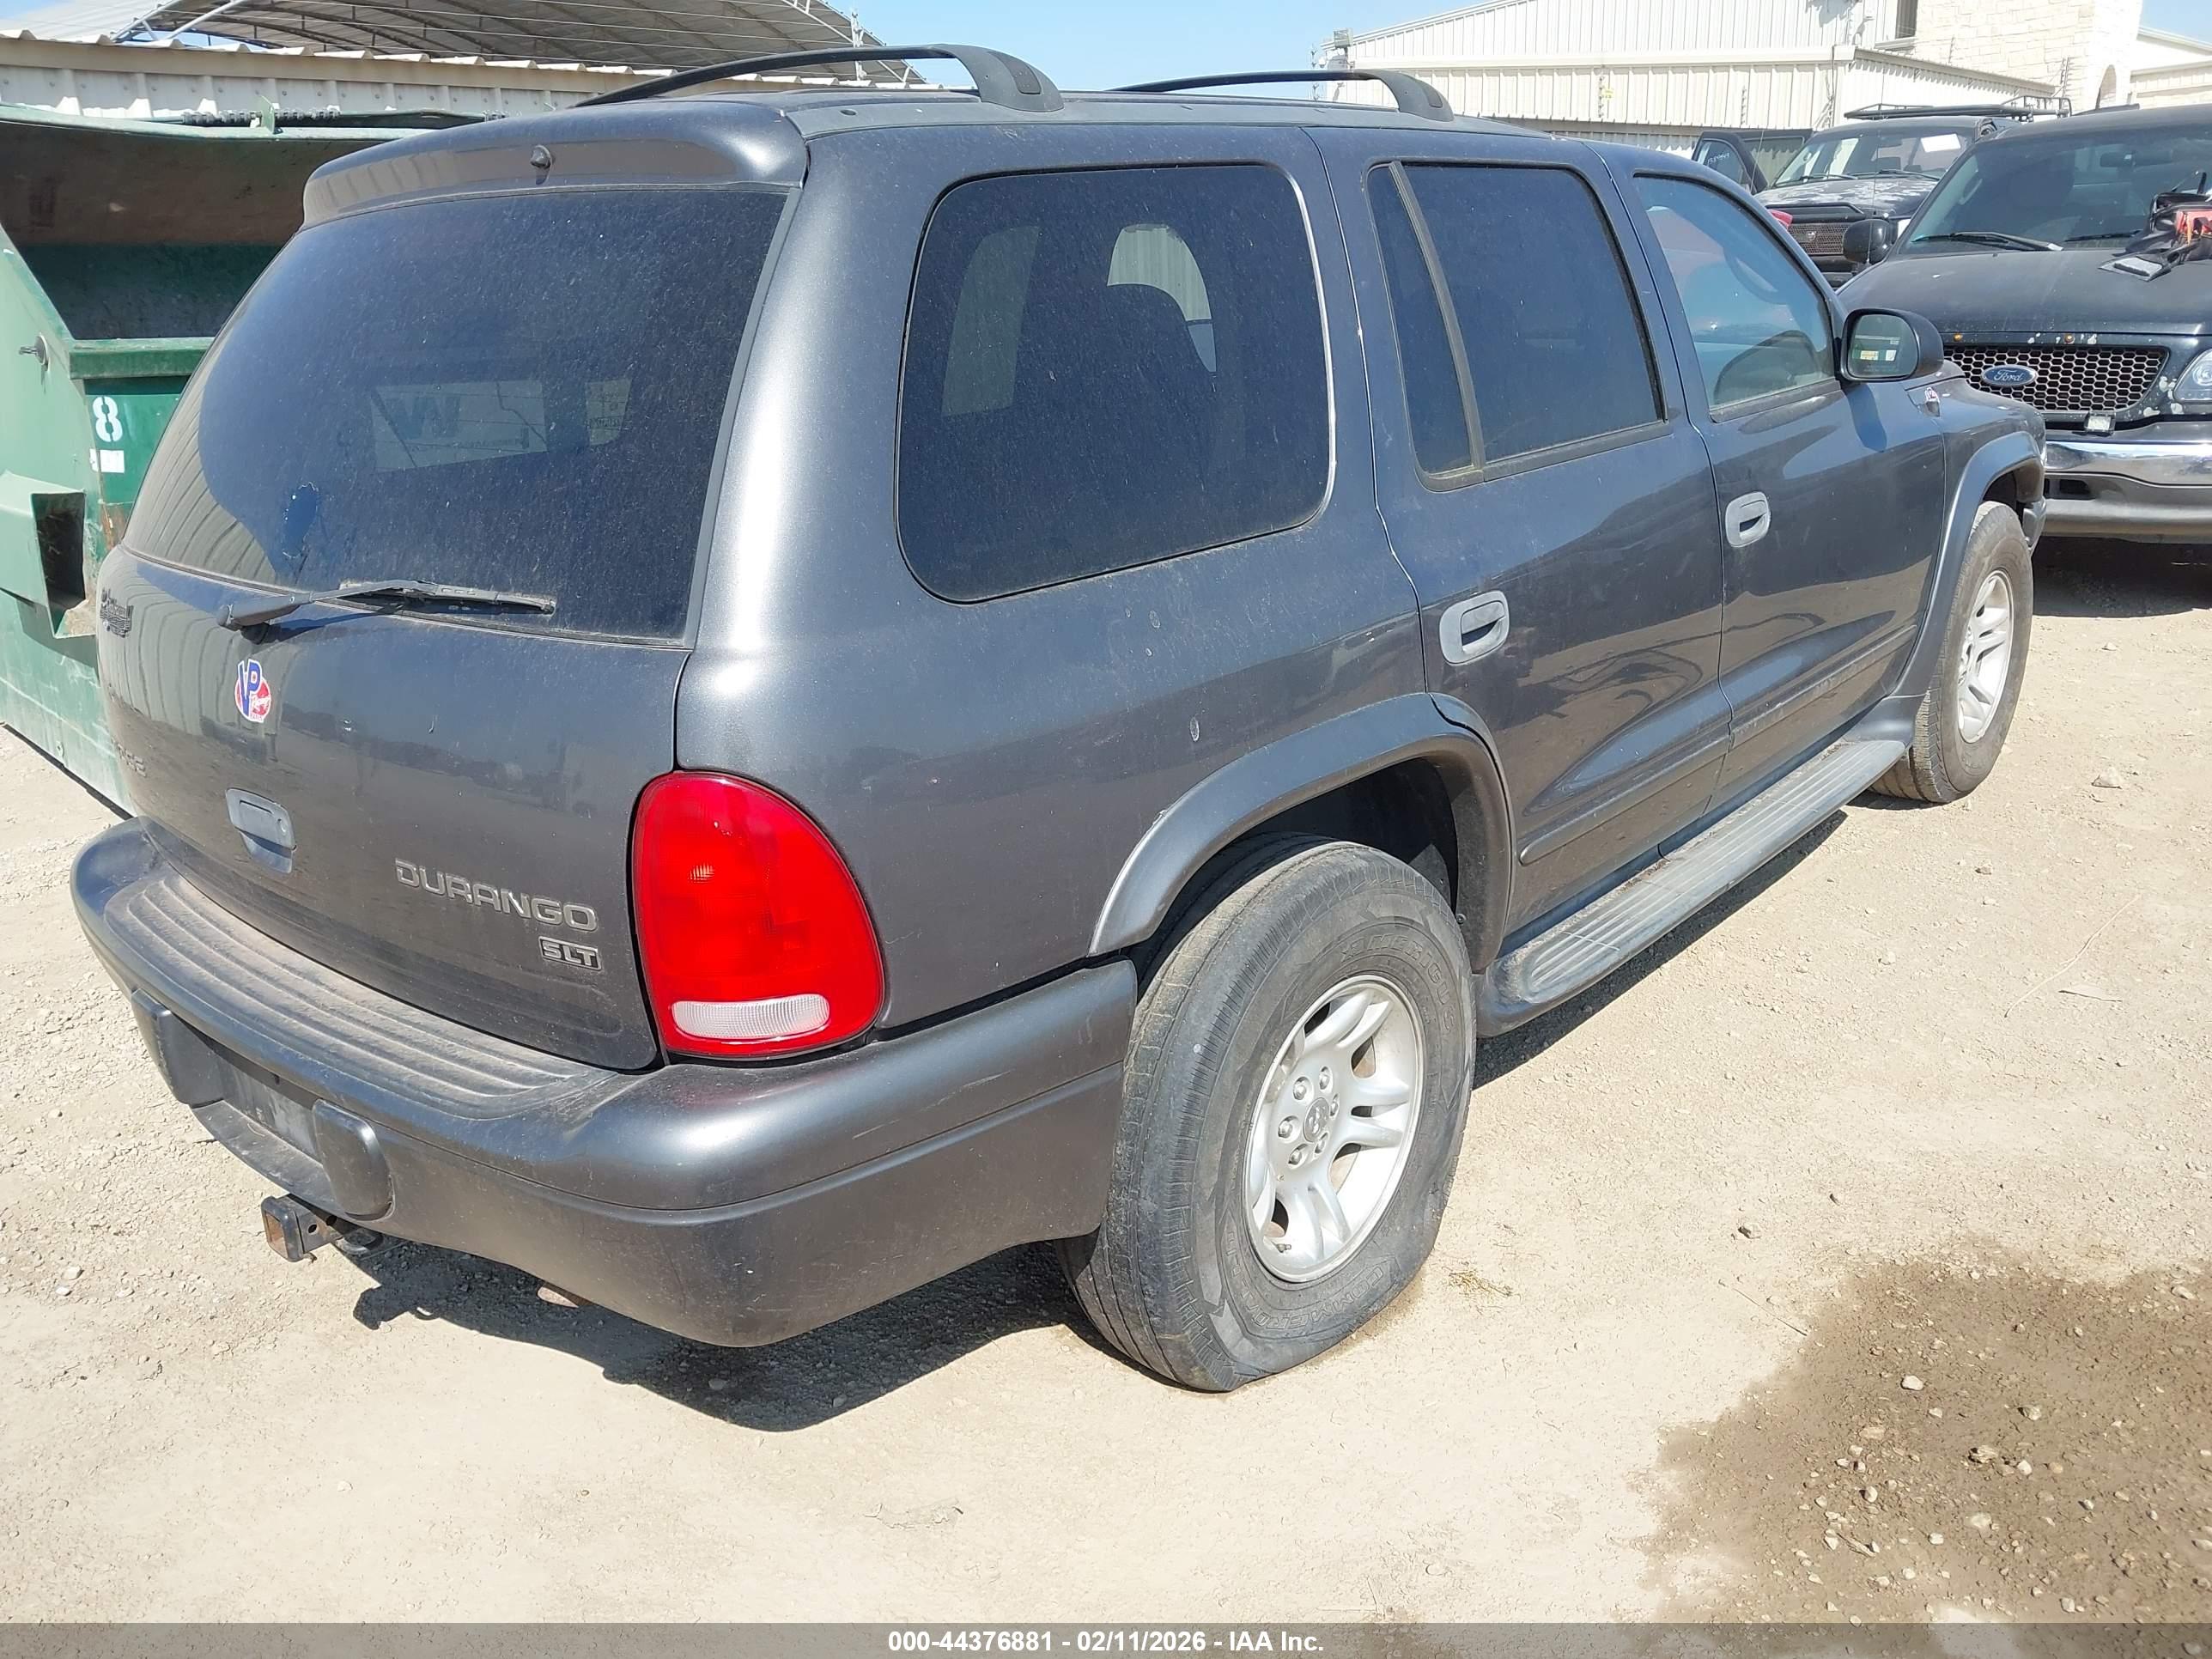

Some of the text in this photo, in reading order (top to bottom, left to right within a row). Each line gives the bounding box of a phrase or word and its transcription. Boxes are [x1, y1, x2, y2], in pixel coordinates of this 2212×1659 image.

[92, 396, 124, 442] 8
[238, 661, 261, 716] VP
[395, 858, 599, 932] DURANGO
[542, 940, 599, 967] SLT
